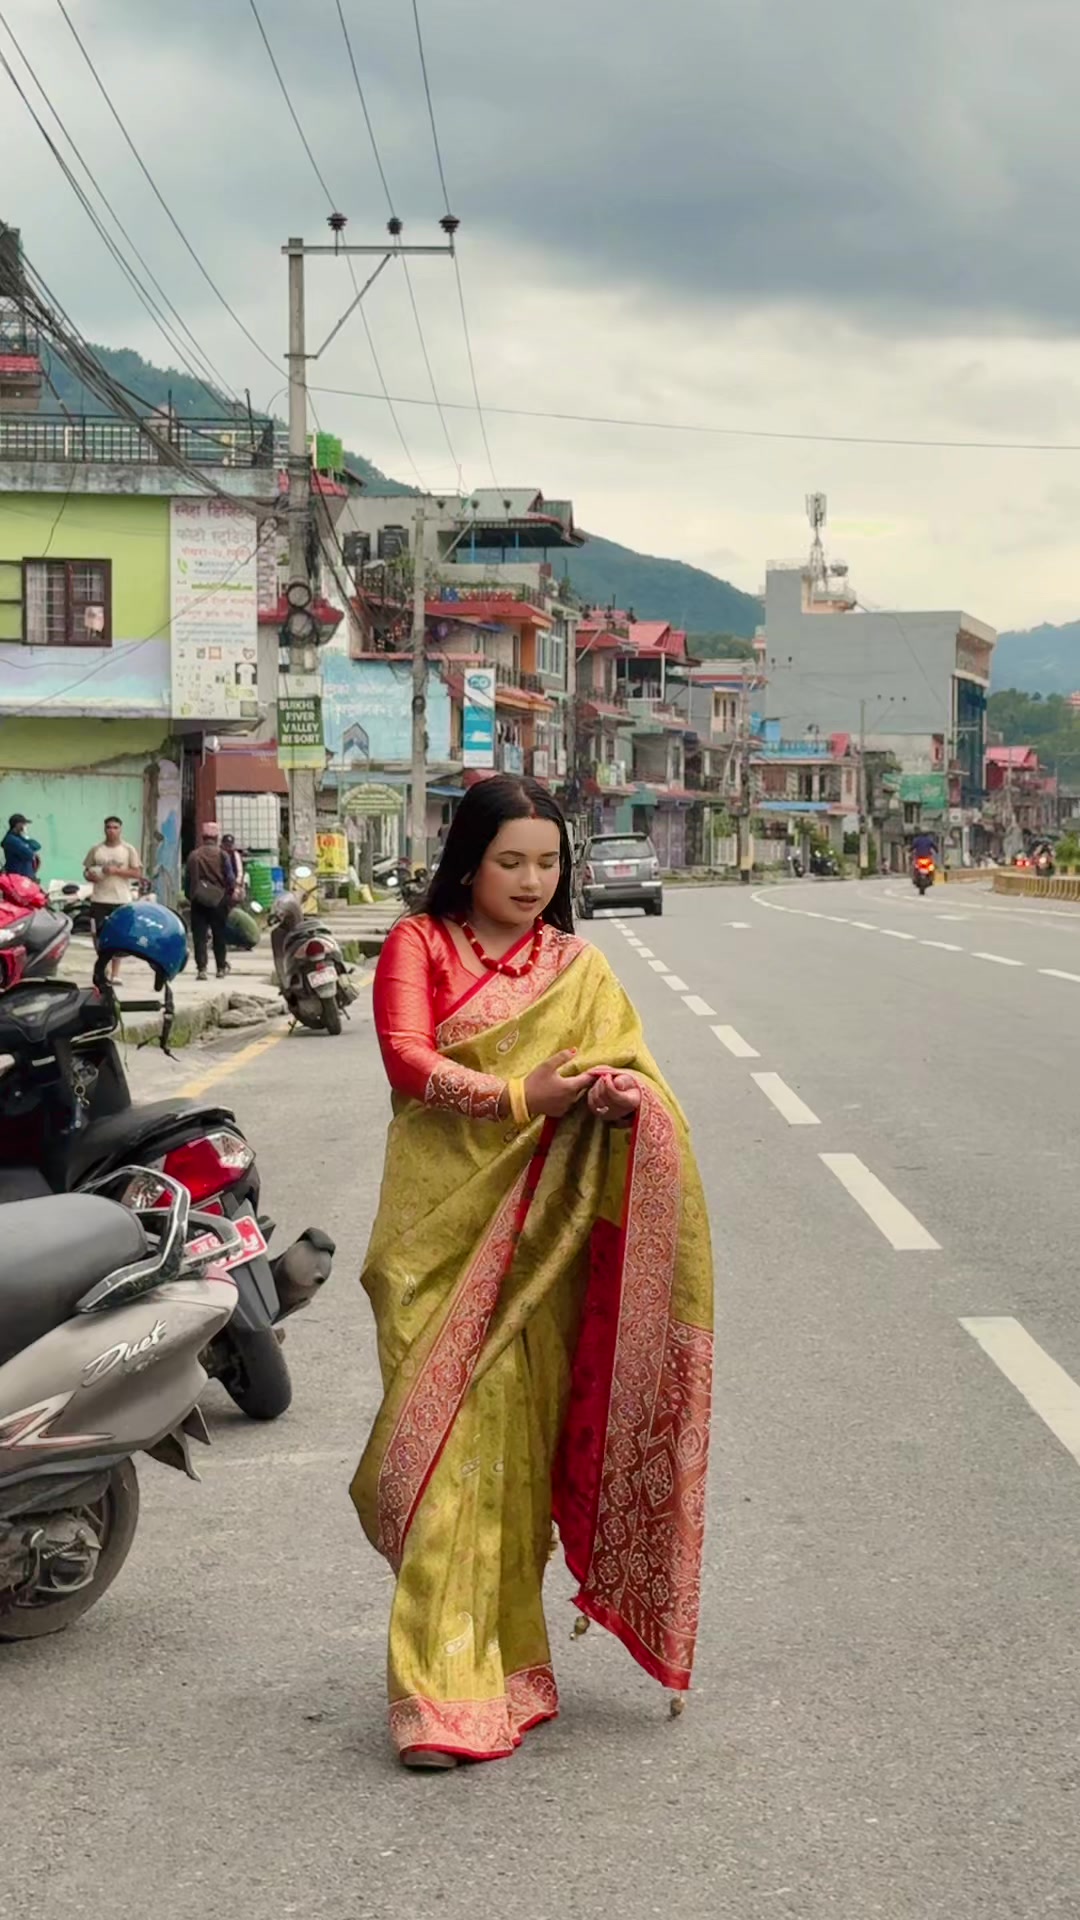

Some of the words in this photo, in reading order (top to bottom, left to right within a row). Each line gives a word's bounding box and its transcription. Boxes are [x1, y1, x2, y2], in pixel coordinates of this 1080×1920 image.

[286, 712, 315, 721] RIVER
[282, 723, 319, 733] VALLEY
[281, 734, 320, 744] RESORT
[82, 1319, 167, 1388] Duet
